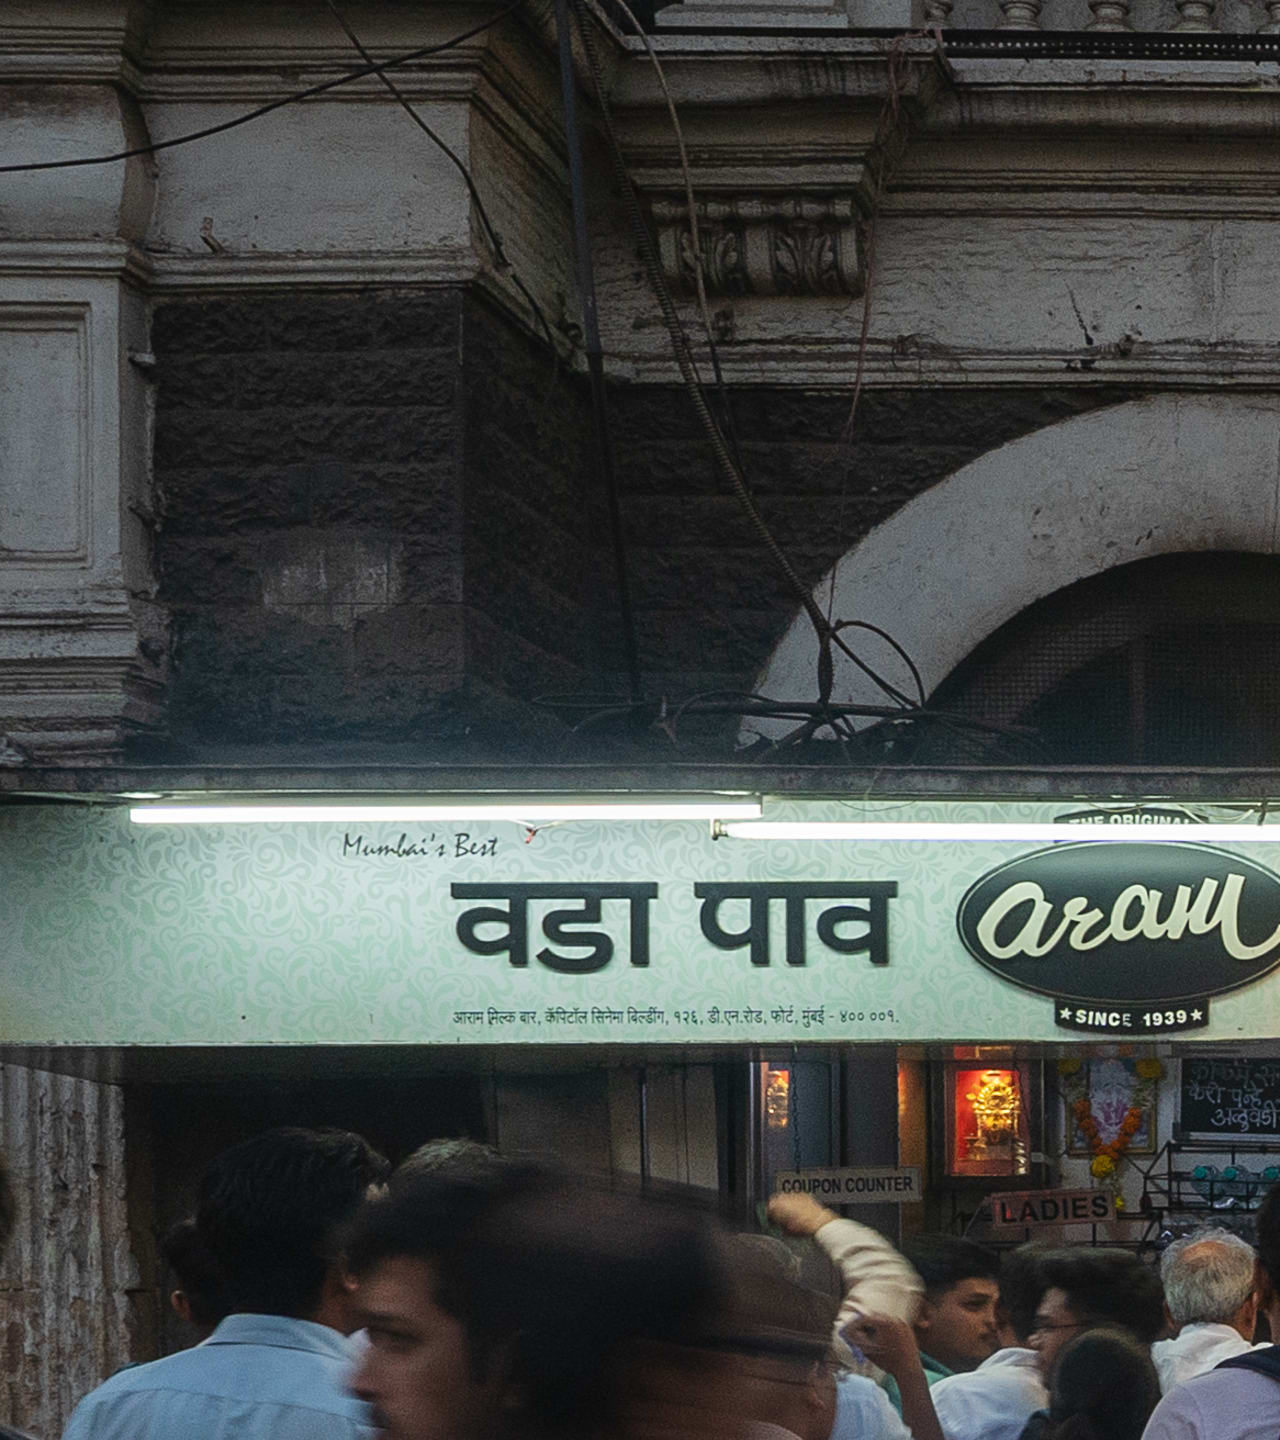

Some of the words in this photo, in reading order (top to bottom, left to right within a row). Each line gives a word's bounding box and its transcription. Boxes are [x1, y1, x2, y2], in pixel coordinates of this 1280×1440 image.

[343, 834, 447, 858] Mumbai's
[456, 834, 497, 857] Best
[451, 882, 658, 975] वडा
[694, 881, 898, 967] पाव
[453, 1012, 484, 1024] आराम
[487, 1007, 516, 1026] मिल्क
[520, 1011, 541, 1026] बार,
[591, 1007, 624, 1024] सिनेमा
[770, 1006, 798, 1026] फोर्ट,
[802, 1007, 825, 1028] मुंबई
[840, 1010, 864, 1023] ४००
[1076, 1009, 1131, 1027] SINCE
[1143, 1010, 1187, 1026] 1939
[781, 1178, 842, 1195] COUPON
[845, 1174, 913, 1193] COUNTER
[1001, 1195, 1108, 1224] LADIES
